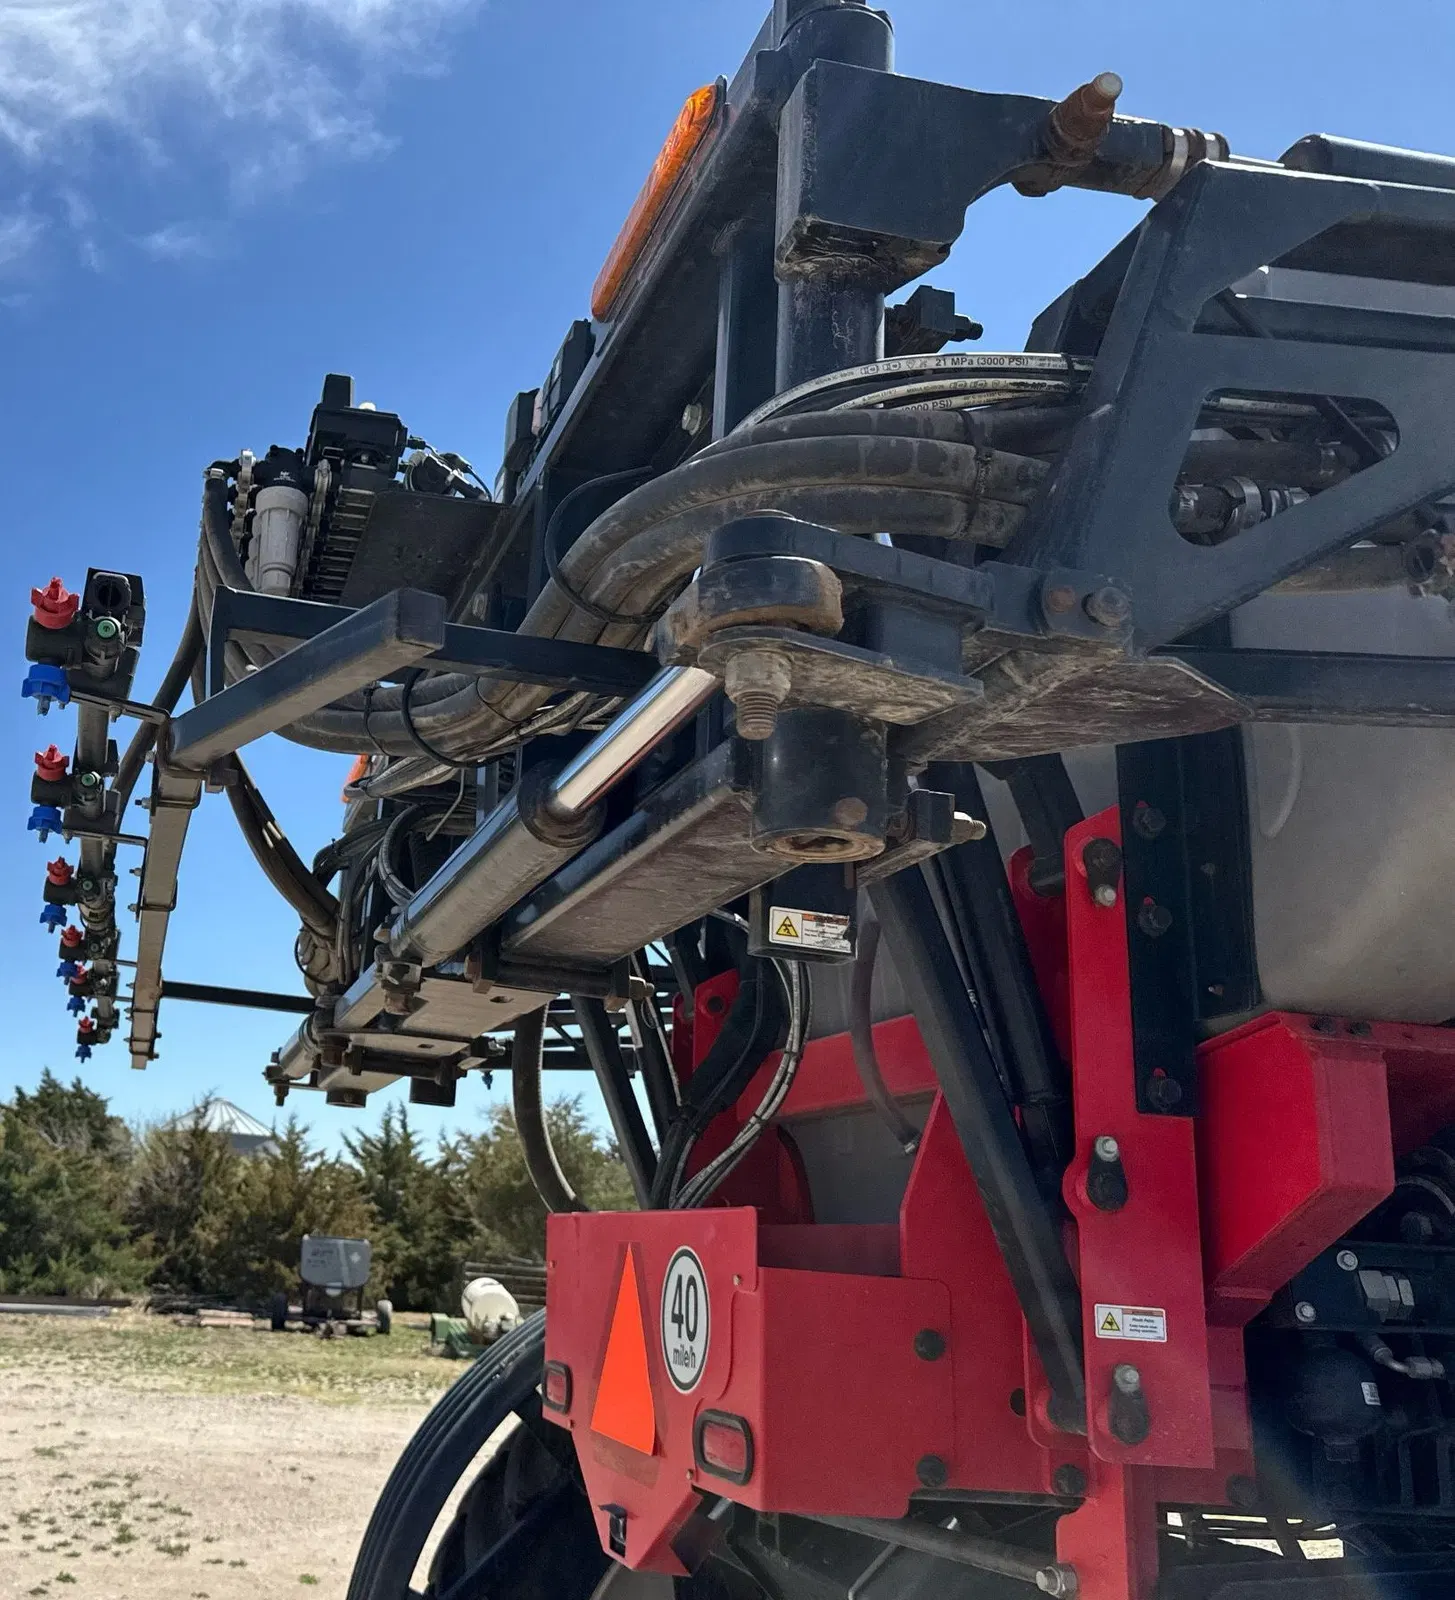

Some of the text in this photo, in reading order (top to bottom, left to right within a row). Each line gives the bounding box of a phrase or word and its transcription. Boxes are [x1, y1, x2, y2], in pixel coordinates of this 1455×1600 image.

[935, 357, 947, 367] 21
[951, 357, 974, 366] MPa
[977, 356, 1005, 367] (3000
[1008, 356, 1029, 366] PSI)
[671, 1274, 698, 1342] 40
[673, 1344, 696, 1369] mile/h
